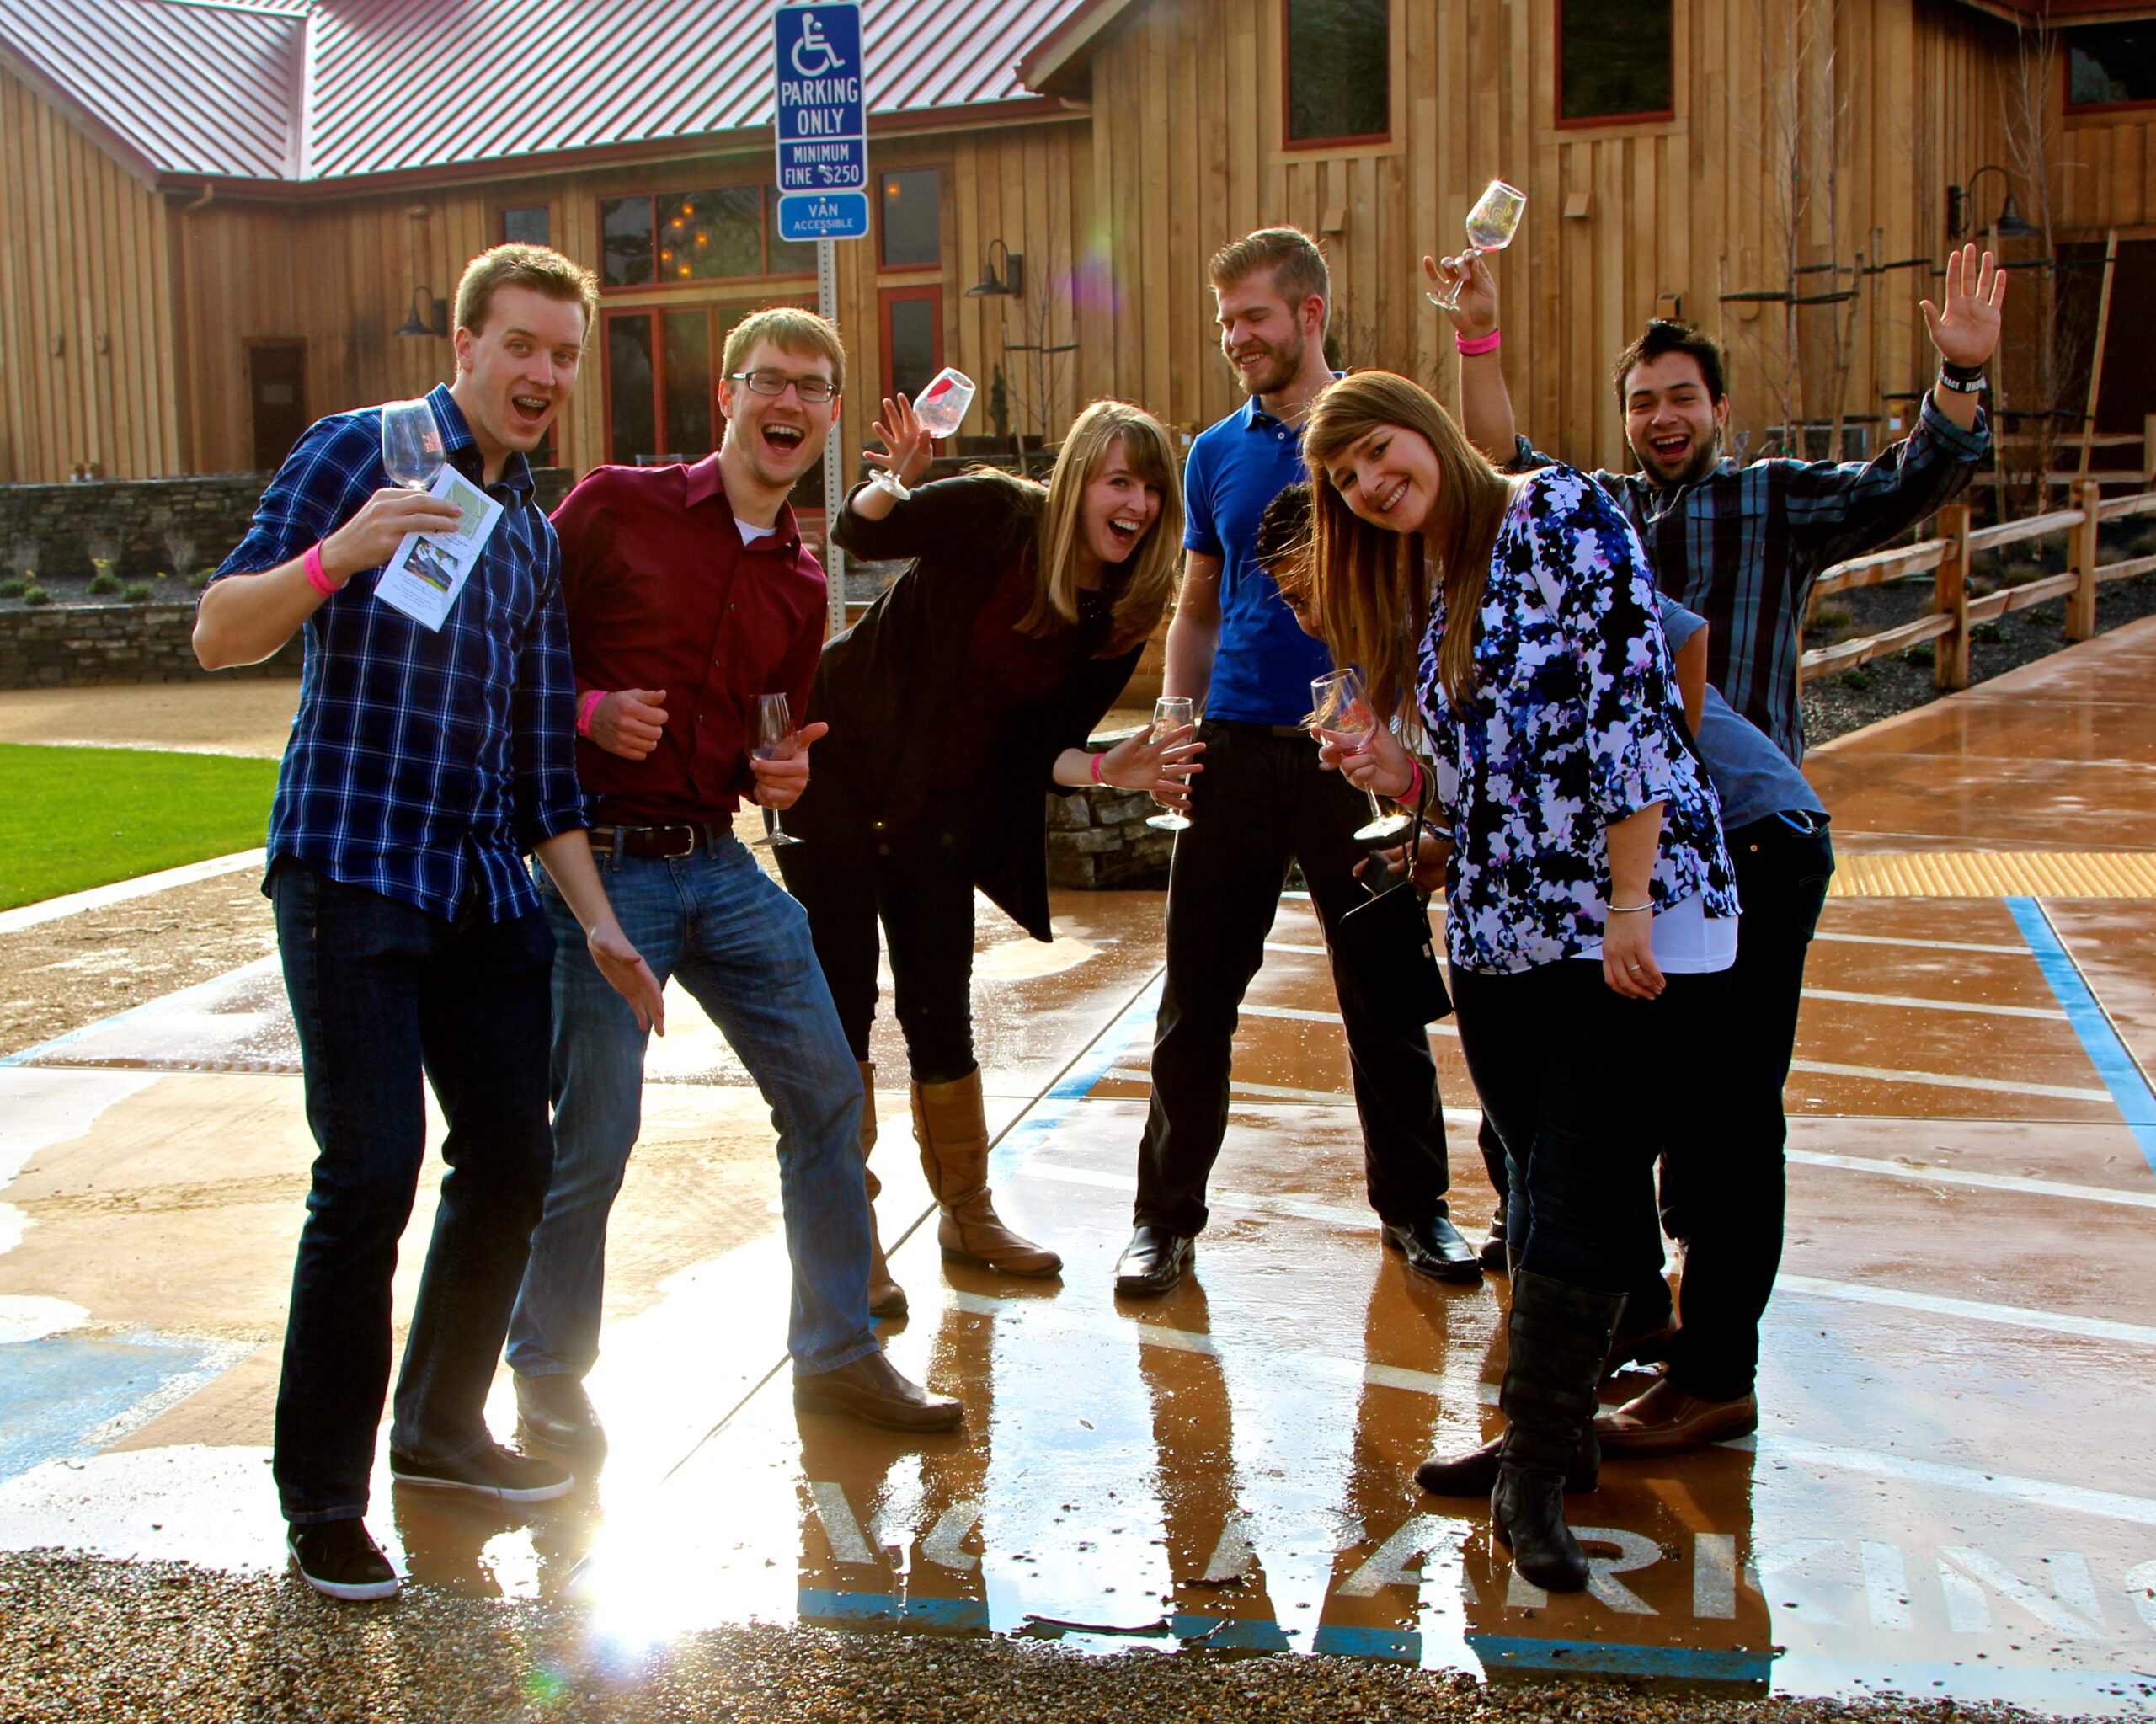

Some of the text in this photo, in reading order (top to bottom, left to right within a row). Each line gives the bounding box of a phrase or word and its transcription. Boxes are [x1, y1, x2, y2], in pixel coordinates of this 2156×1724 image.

[782, 77, 858, 106] PARKING
[798, 109, 844, 136] ONLY
[793, 143, 849, 163] MINIMUM
[785, 164, 859, 185] FINE $250
[808, 203, 838, 217] VAN
[794, 218, 853, 230] ACCESSIBLE
